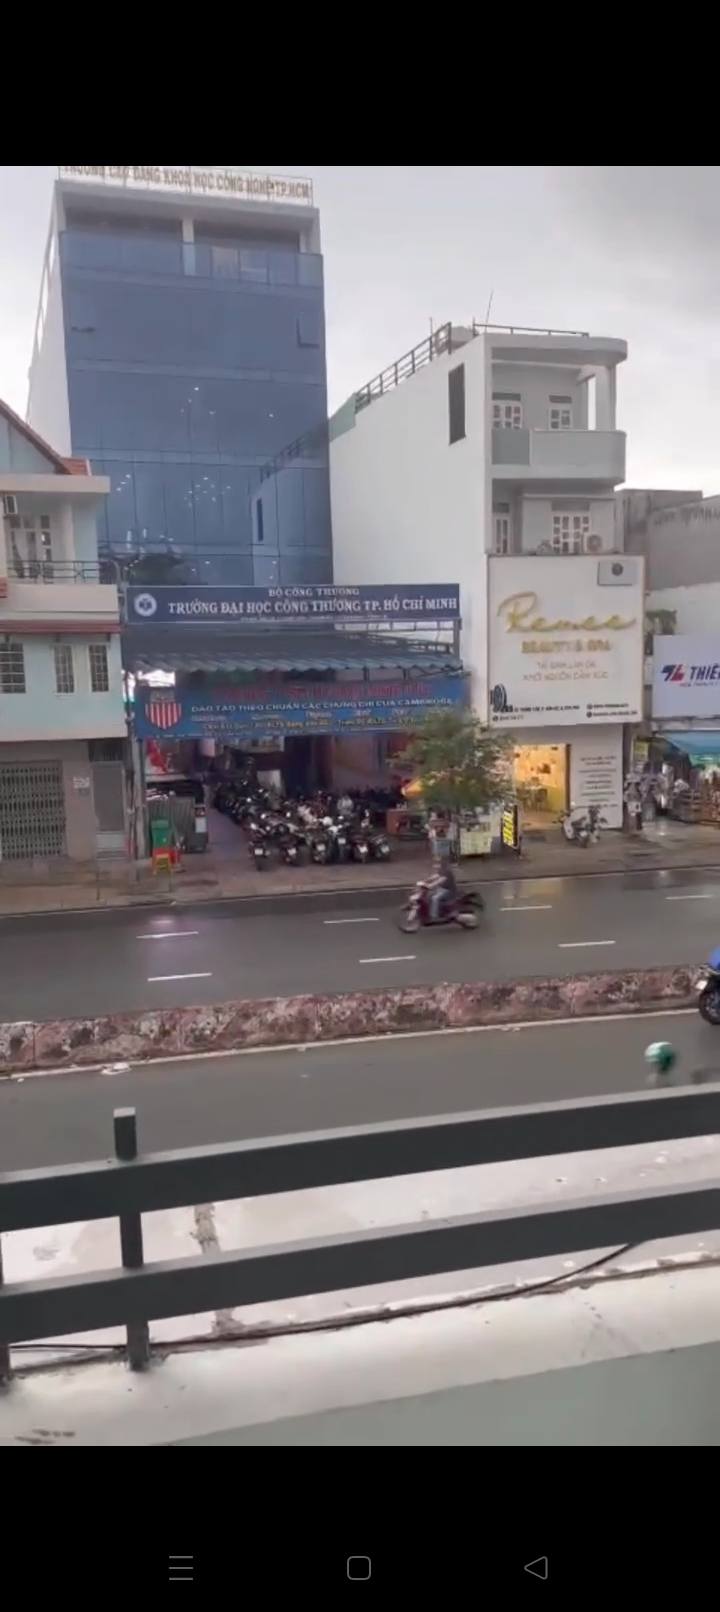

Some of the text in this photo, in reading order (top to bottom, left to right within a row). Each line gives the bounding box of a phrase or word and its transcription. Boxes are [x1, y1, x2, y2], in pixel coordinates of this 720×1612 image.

[168, 598, 218, 615] TRƯỜNG
[220, 602, 244, 616] ĐẠI
[246, 602, 271, 617] HỌC
[274, 599, 309, 614] CÔNG
[402, 595, 424, 610] CHÍ
[426, 598, 457, 610] MINH
